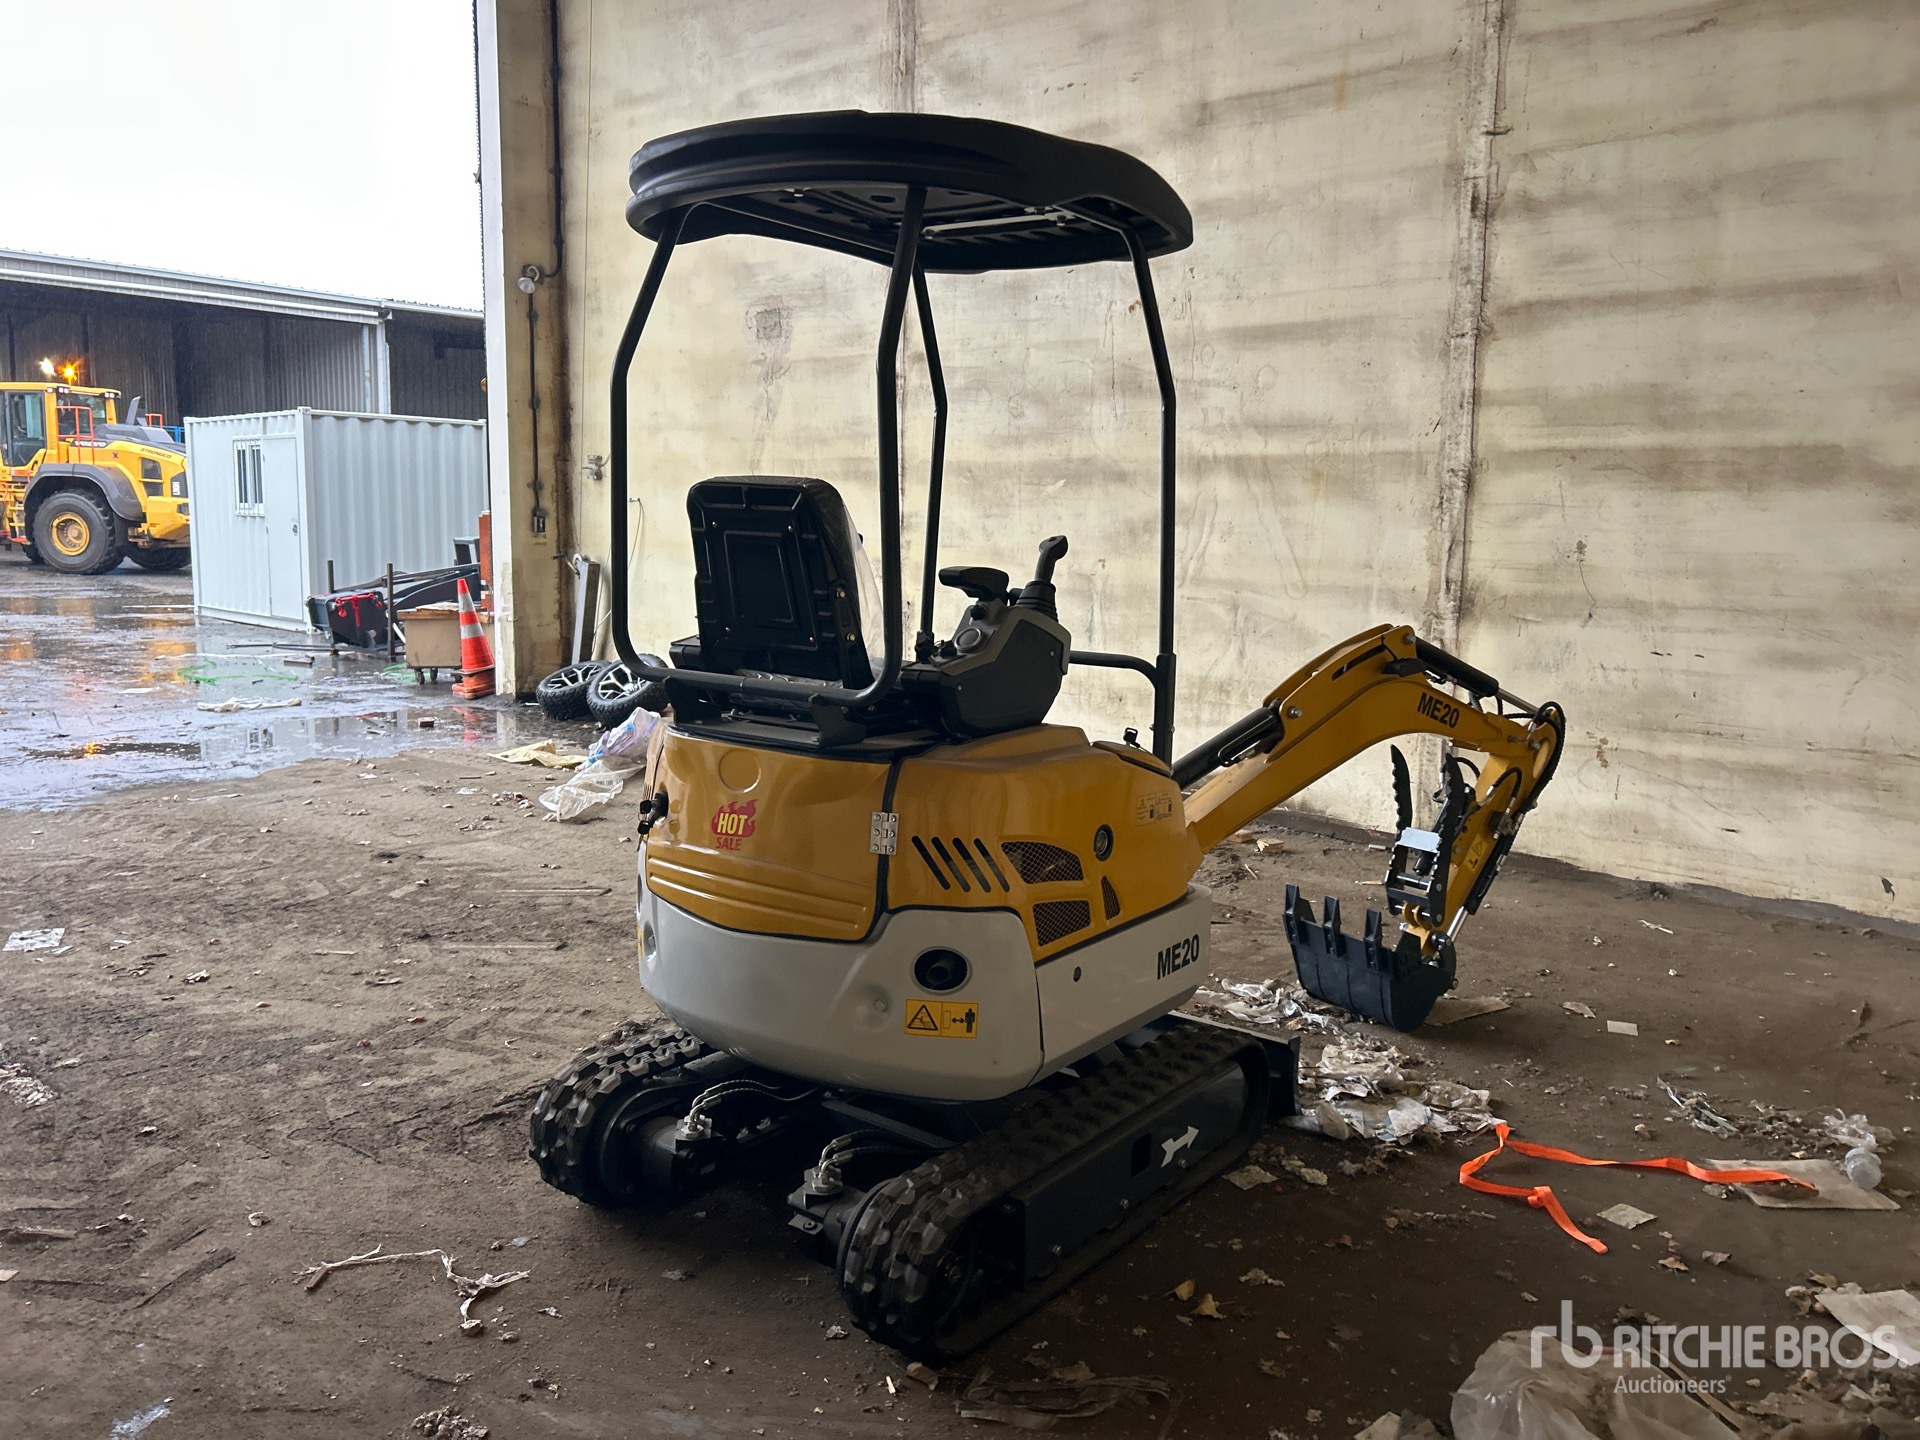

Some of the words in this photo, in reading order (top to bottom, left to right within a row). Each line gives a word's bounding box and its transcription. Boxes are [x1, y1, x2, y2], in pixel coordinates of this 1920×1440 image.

[74, 440, 107, 448] VOLVO
[1417, 691, 1460, 729] ME20
[717, 812, 748, 836] HOT
[715, 836, 742, 851] SALE
[1156, 933, 1200, 980] ME20
